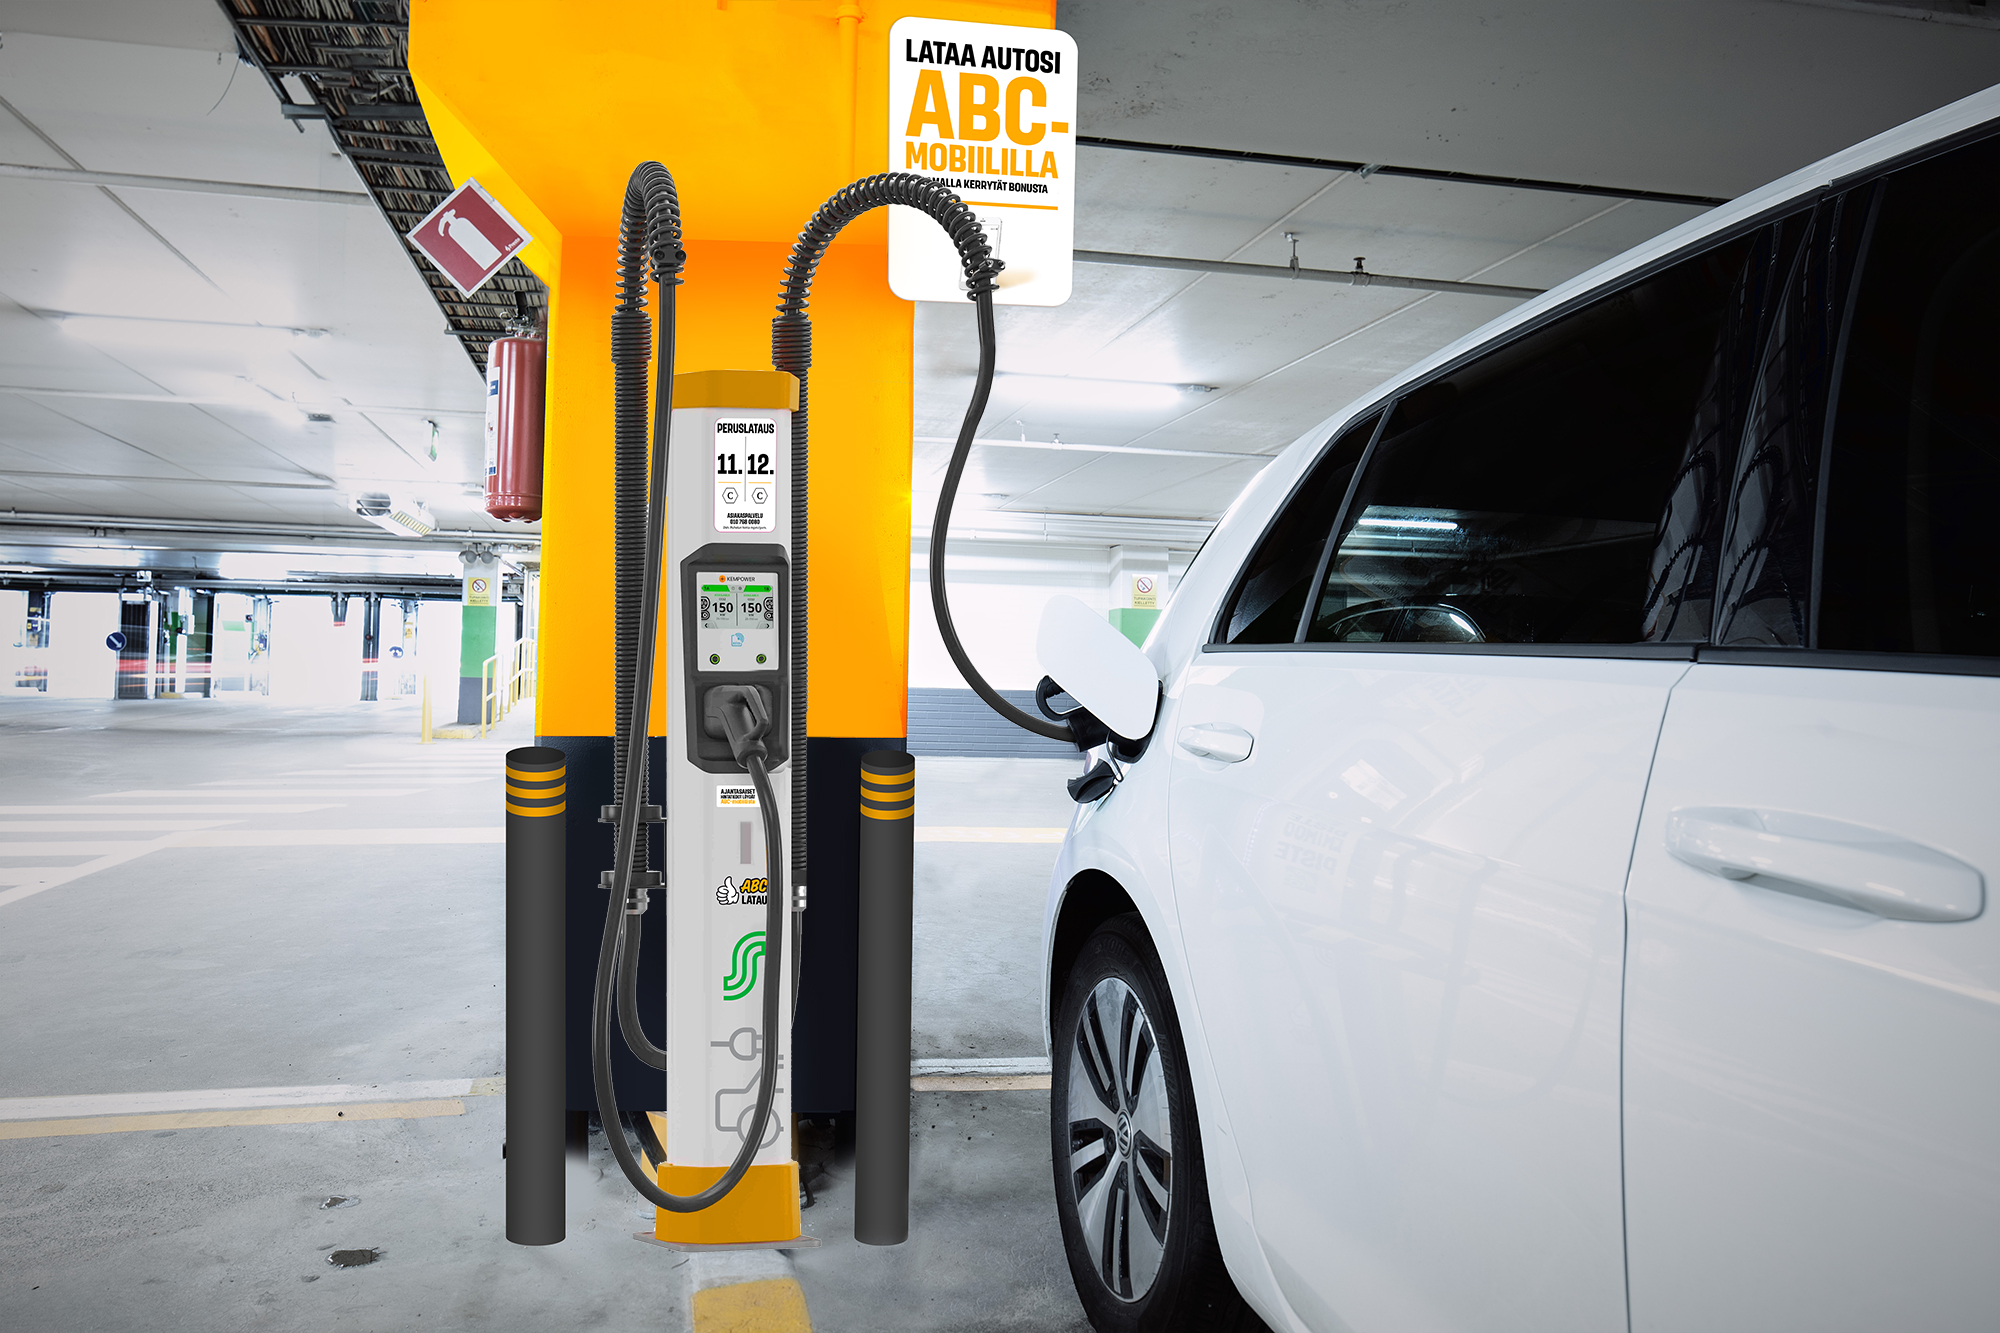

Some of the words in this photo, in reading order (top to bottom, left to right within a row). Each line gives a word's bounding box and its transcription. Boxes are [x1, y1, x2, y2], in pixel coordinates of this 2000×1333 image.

[906, 39, 976, 67] LATAA
[981, 45, 1061, 74] AUTOSI
[905, 69, 1069, 146] ABC-
[905, 141, 1059, 178] MOBIILILLA
[964, 179, 1007, 191] KERRYTÄT
[1009, 182, 1048, 194] BONUSTA
[717, 423, 775, 434] PERUSLATAUS
[717, 453, 743, 475] 11.
[747, 453, 774, 475] 12.
[712, 602, 733, 613] 150
[741, 602, 762, 613] 150
[740, 878, 768, 893] ABC
[742, 895, 768, 905] LATAU
